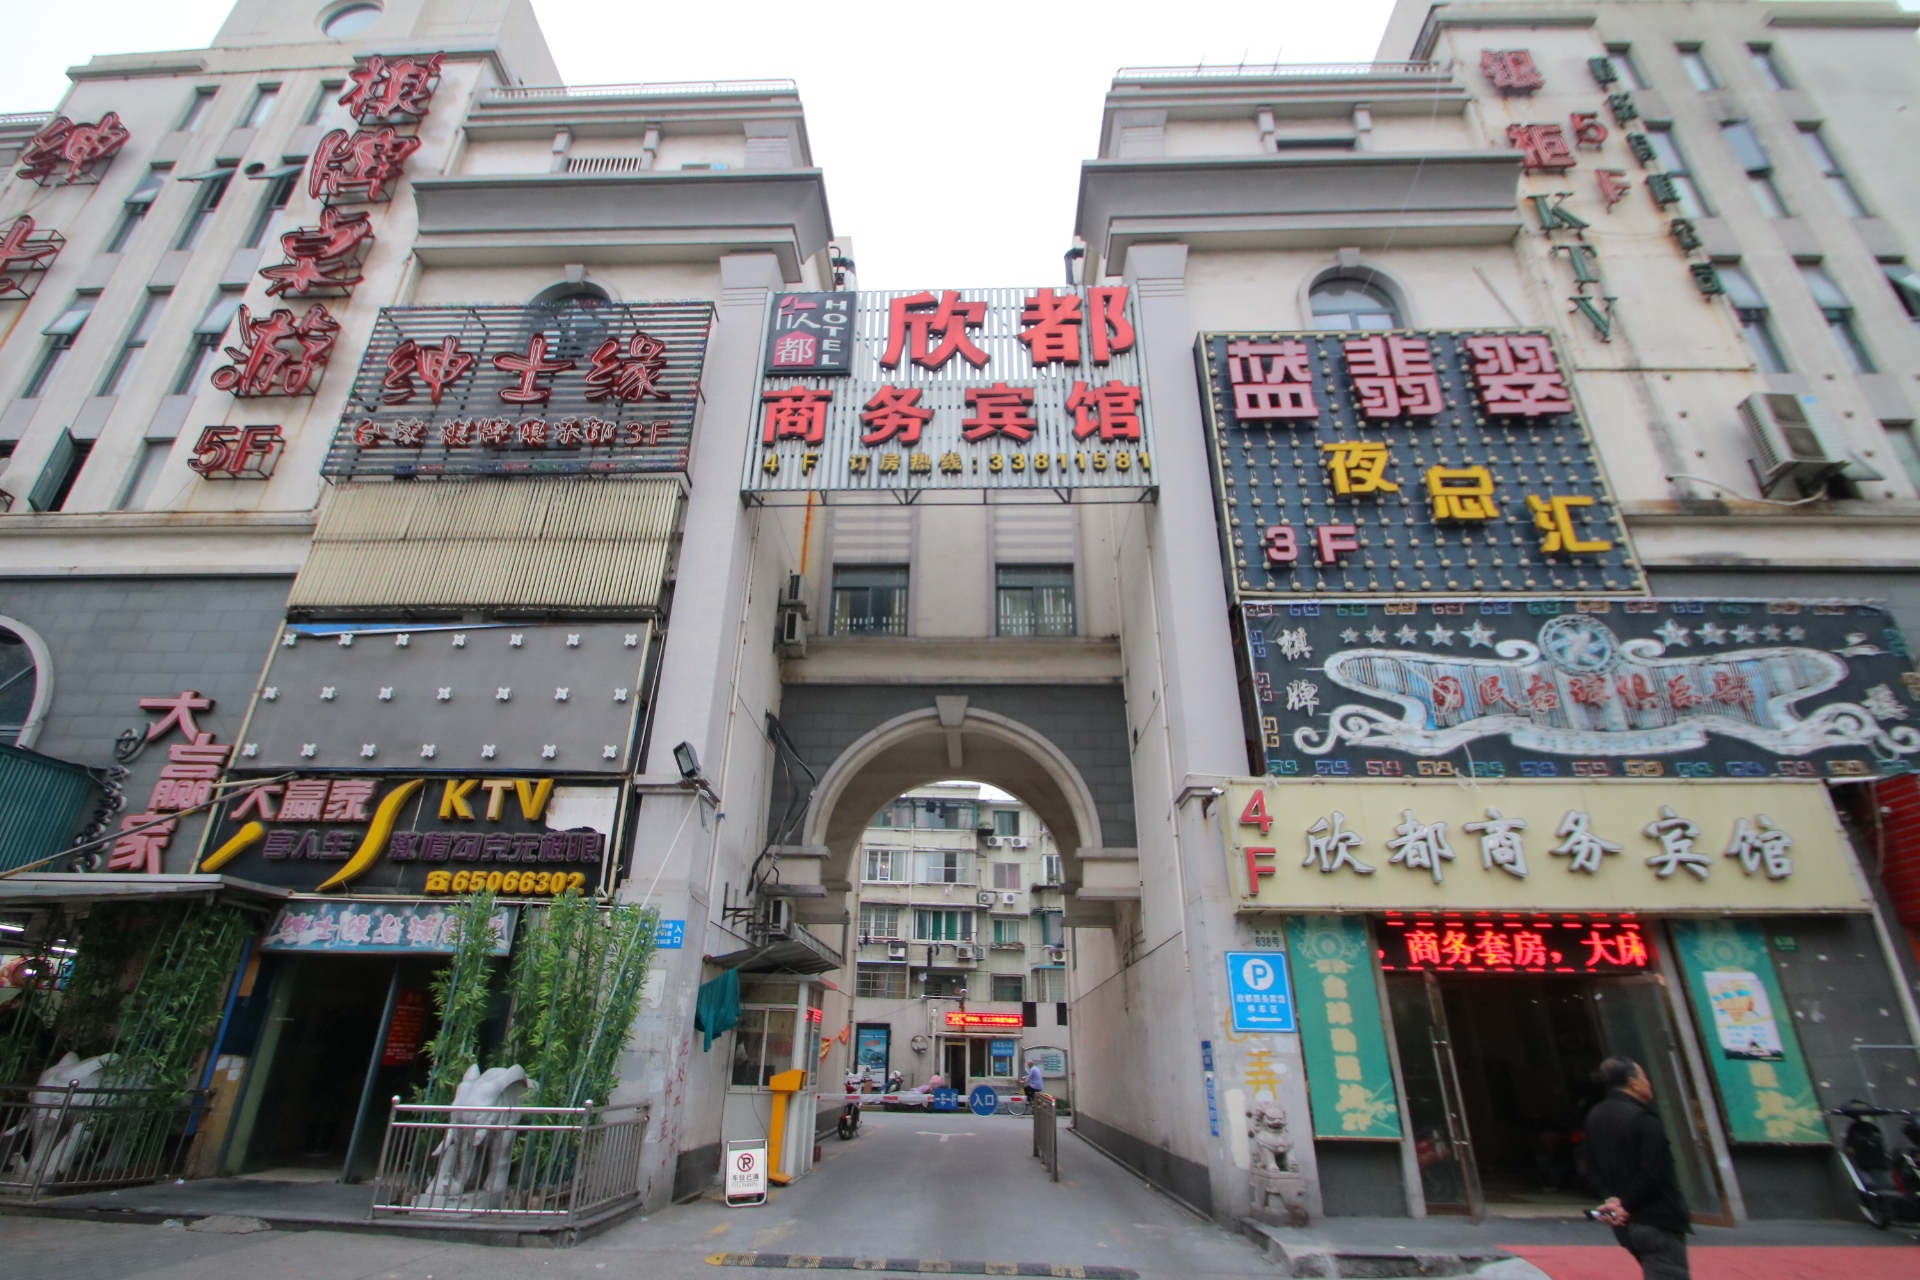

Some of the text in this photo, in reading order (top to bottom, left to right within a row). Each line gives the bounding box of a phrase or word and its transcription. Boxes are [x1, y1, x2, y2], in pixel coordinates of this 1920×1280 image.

[1527, 192, 1619, 343] KTV
[821, 299, 848, 366] HOTEL
[879, 287, 1136, 371] 欣都
[382, 332, 672, 405] 绅士缘
[1226, 335, 1573, 422] 蓝翡翠
[624, 420, 672, 447] 3F
[762, 379, 1143, 447] 商务宾馆
[187, 423, 283, 476] 5F
[1321, 440, 1613, 553] 夜总汇
[1265, 524, 1359, 566] 3F
[1277, 627, 1320, 717] 棋牌
[107, 690, 231, 874] 大赢家
[230, 778, 555, 821] 大赢家 KTV
[1303, 806, 1795, 884] 欣都商务宾馆
[674, 925, 683, 944] 入口
[1255, 936, 1280, 948] 638号
[1236, 994, 1287, 1004] 欣都商务宾馆
[972, 1094, 995, 1107] 入口
[732, 1172, 760, 1181] 车位已满
